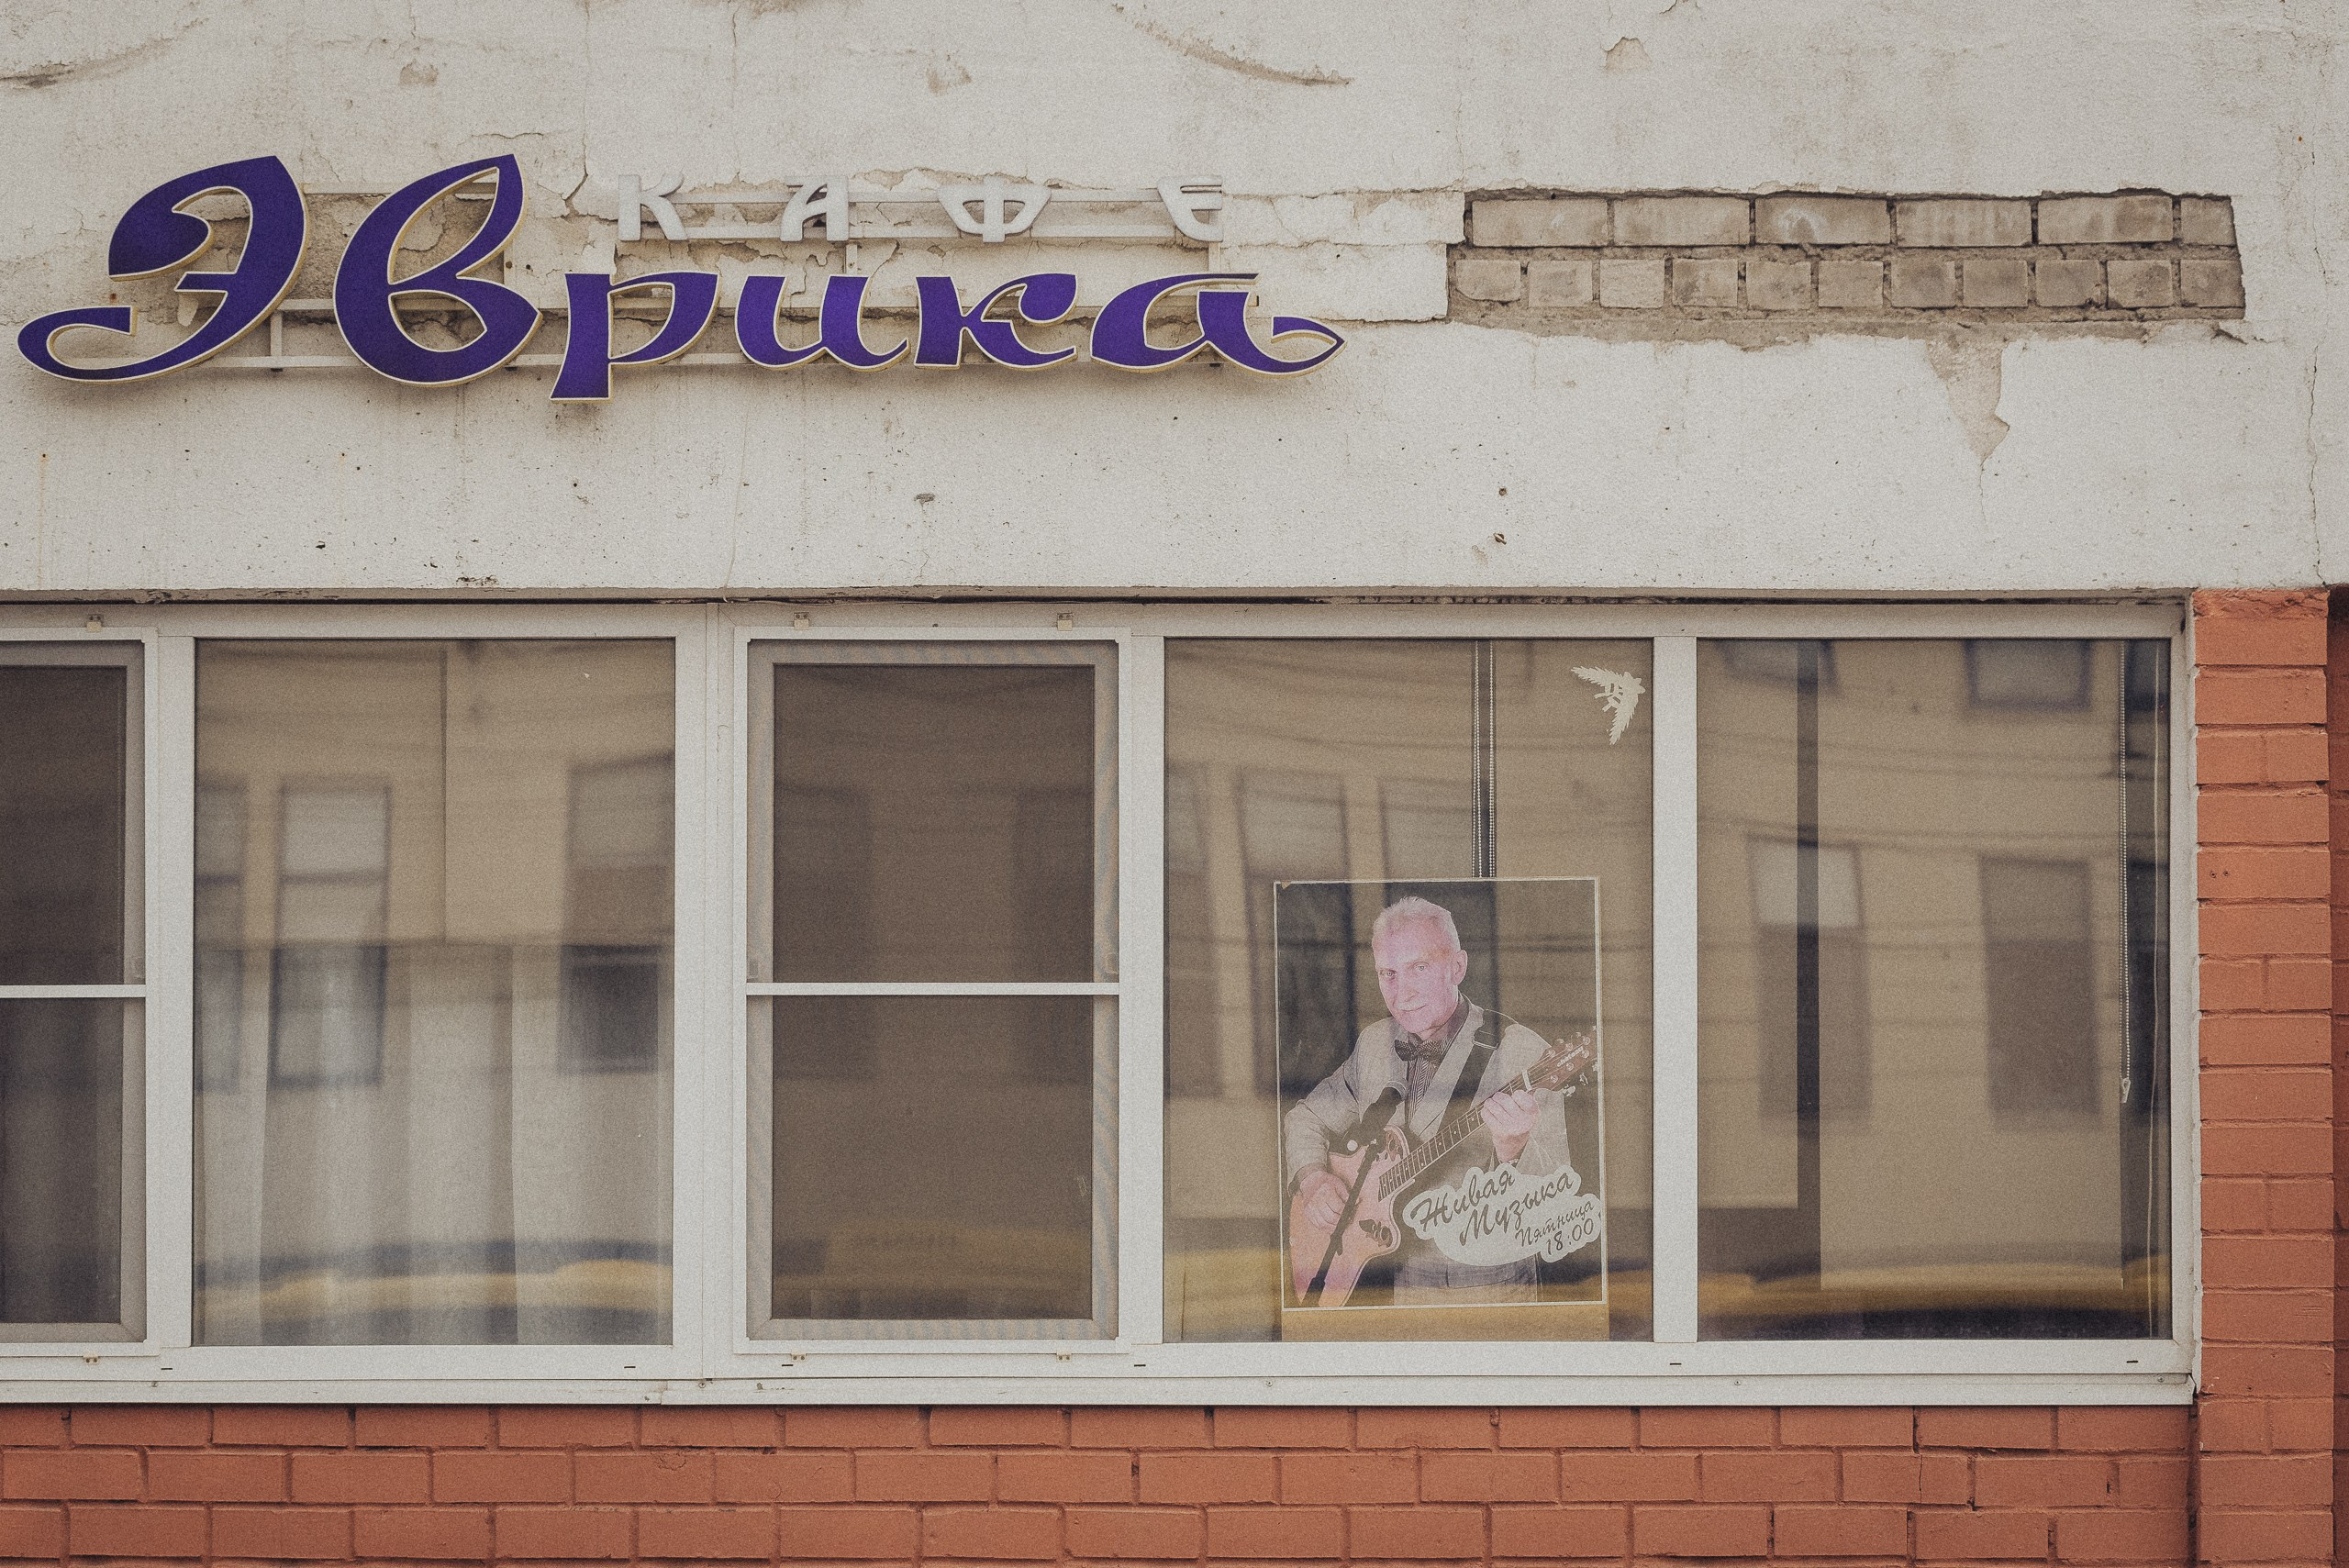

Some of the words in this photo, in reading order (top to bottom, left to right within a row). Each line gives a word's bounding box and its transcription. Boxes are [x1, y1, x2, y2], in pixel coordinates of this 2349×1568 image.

[616, 174, 1222, 242] КАФЕ
[17, 153, 1345, 403] Эврика
[1410, 1170, 1516, 1232] Живая
[1460, 1173, 1575, 1246] Музыка
[1545, 1217, 1595, 1255] 18:00
